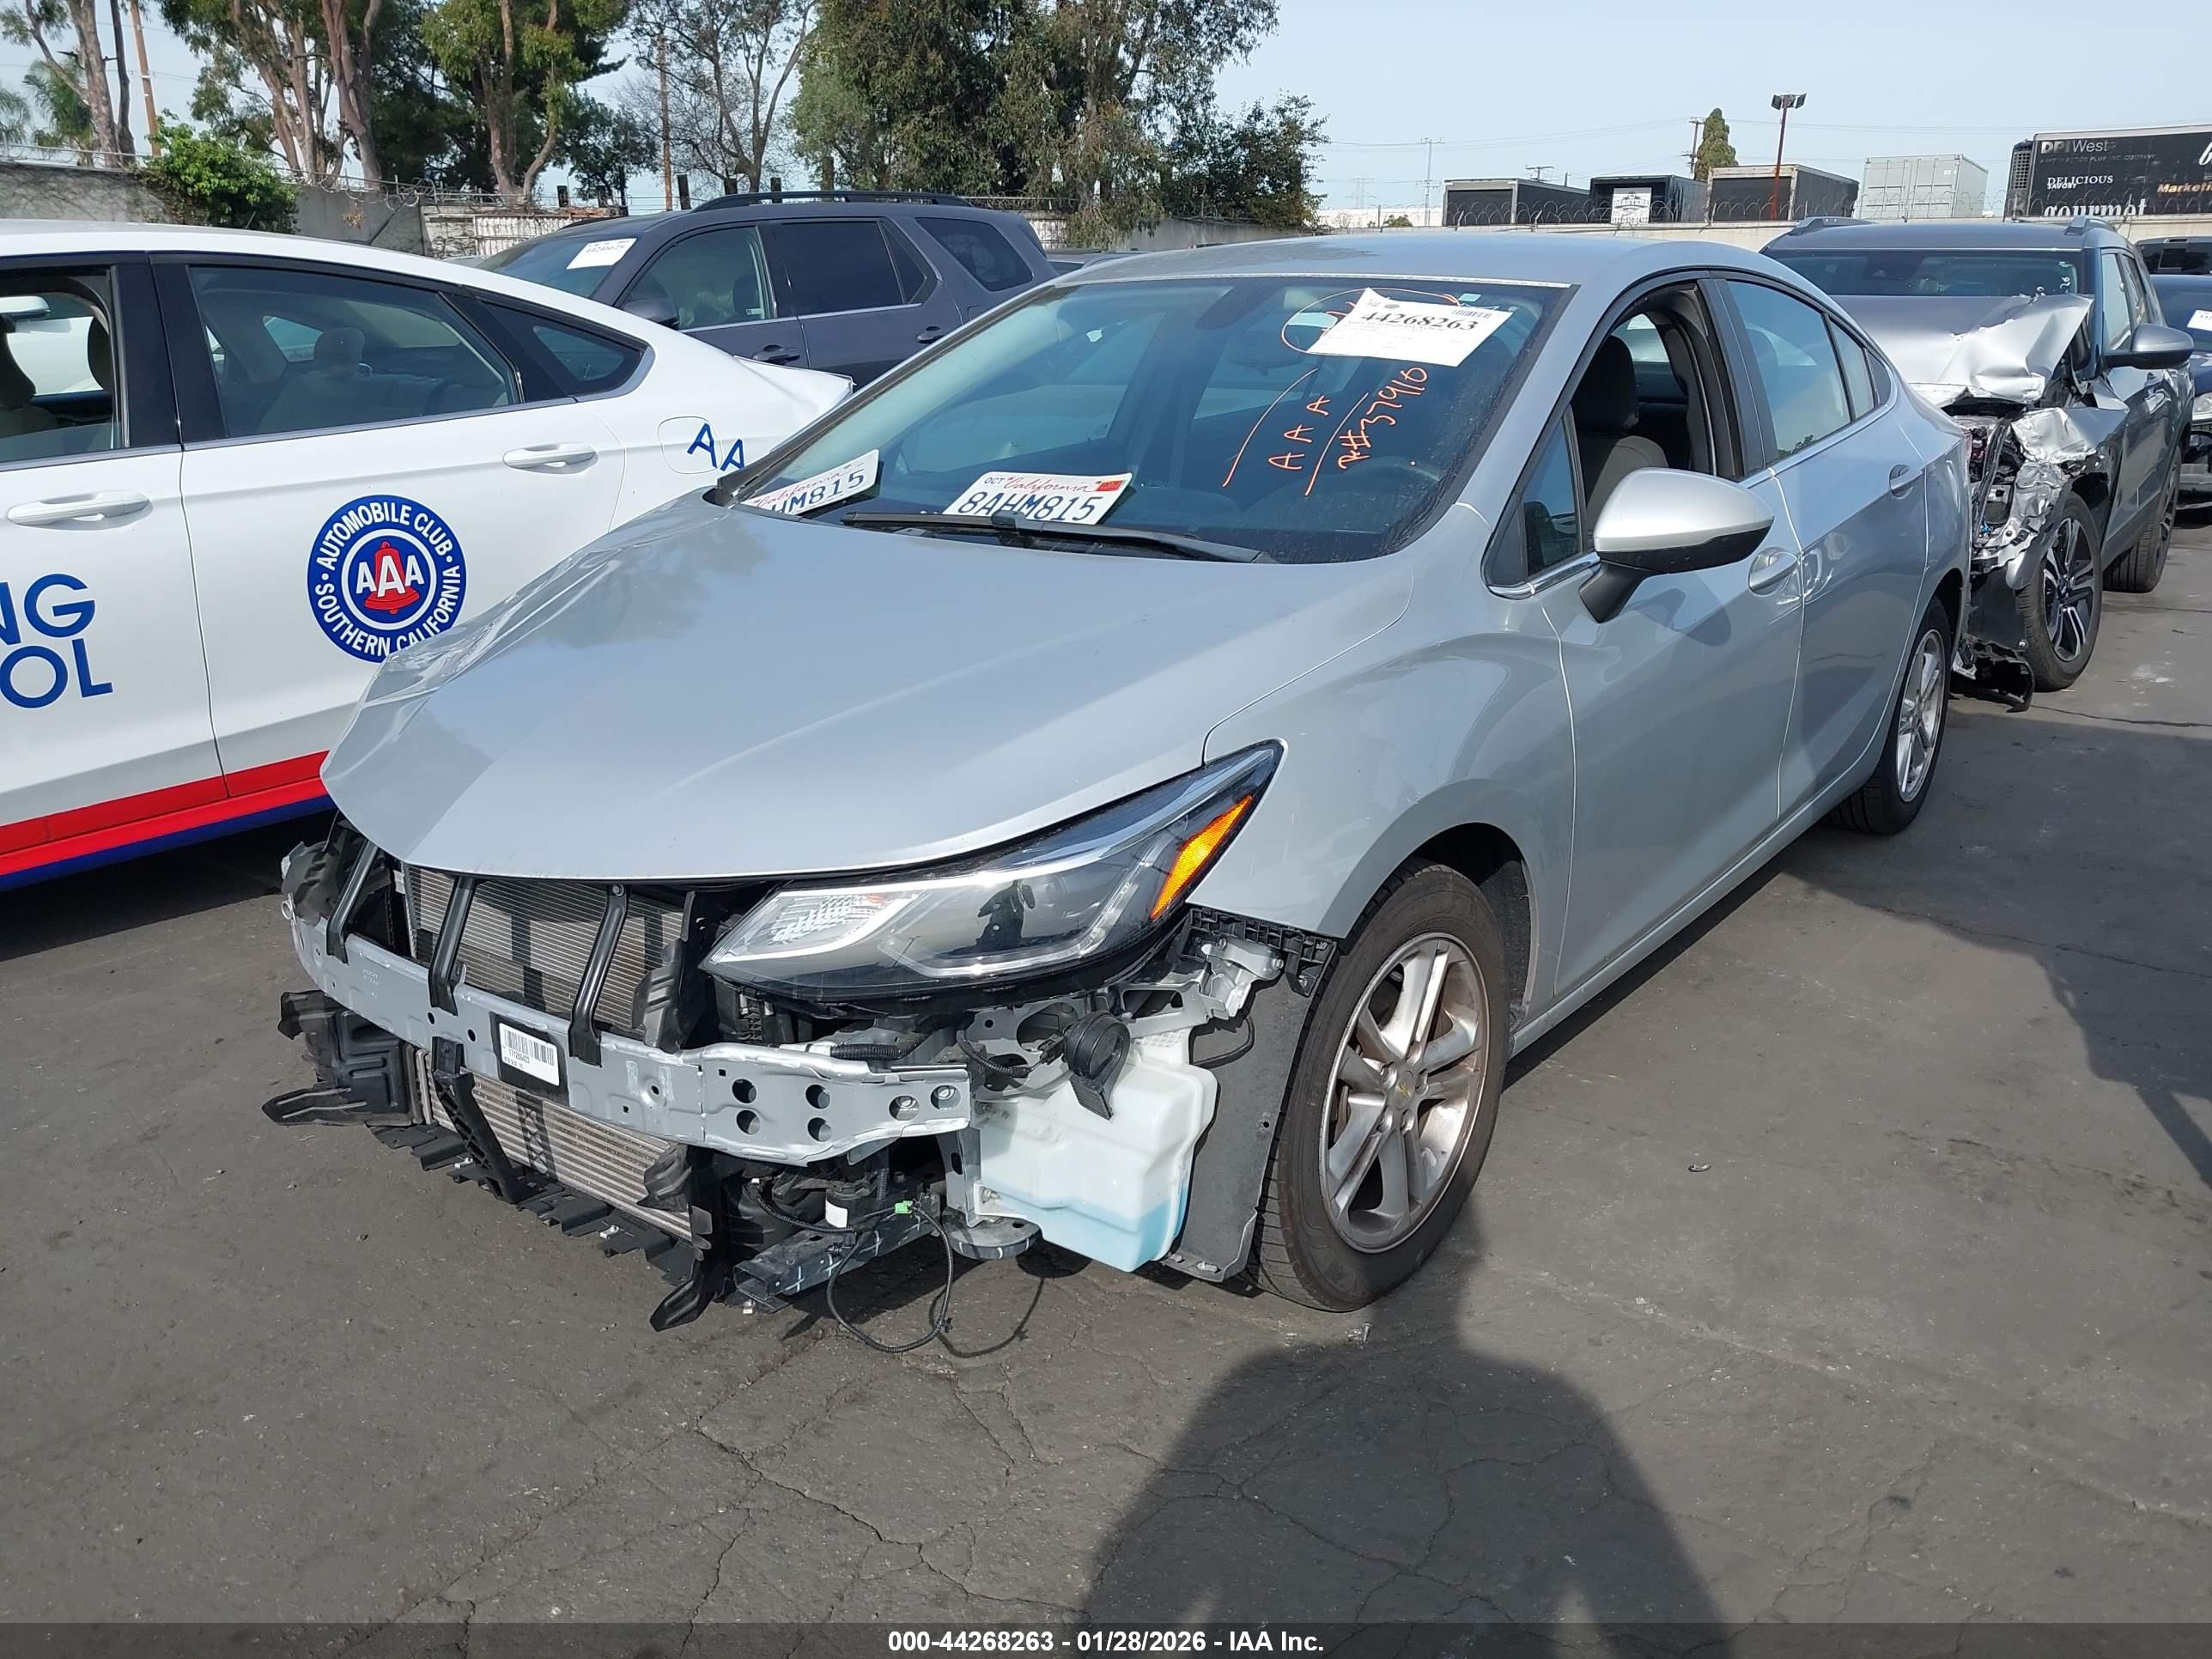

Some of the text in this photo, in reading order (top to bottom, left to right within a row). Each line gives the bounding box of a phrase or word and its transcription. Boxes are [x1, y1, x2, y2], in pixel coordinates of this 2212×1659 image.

[2072, 138, 2108, 154] West
[2047, 174, 2114, 186] DELICIOUS
[1359, 311, 1480, 331] 44268263
[983, 476, 1096, 494] OCT California
[957, 490, 1104, 522] 8AHM815
[316, 501, 453, 571] AUTOMOBILE CLUB
[356, 555, 425, 599] AAA
[315, 564, 461, 657] SOUTHERN CALIFORNIA
